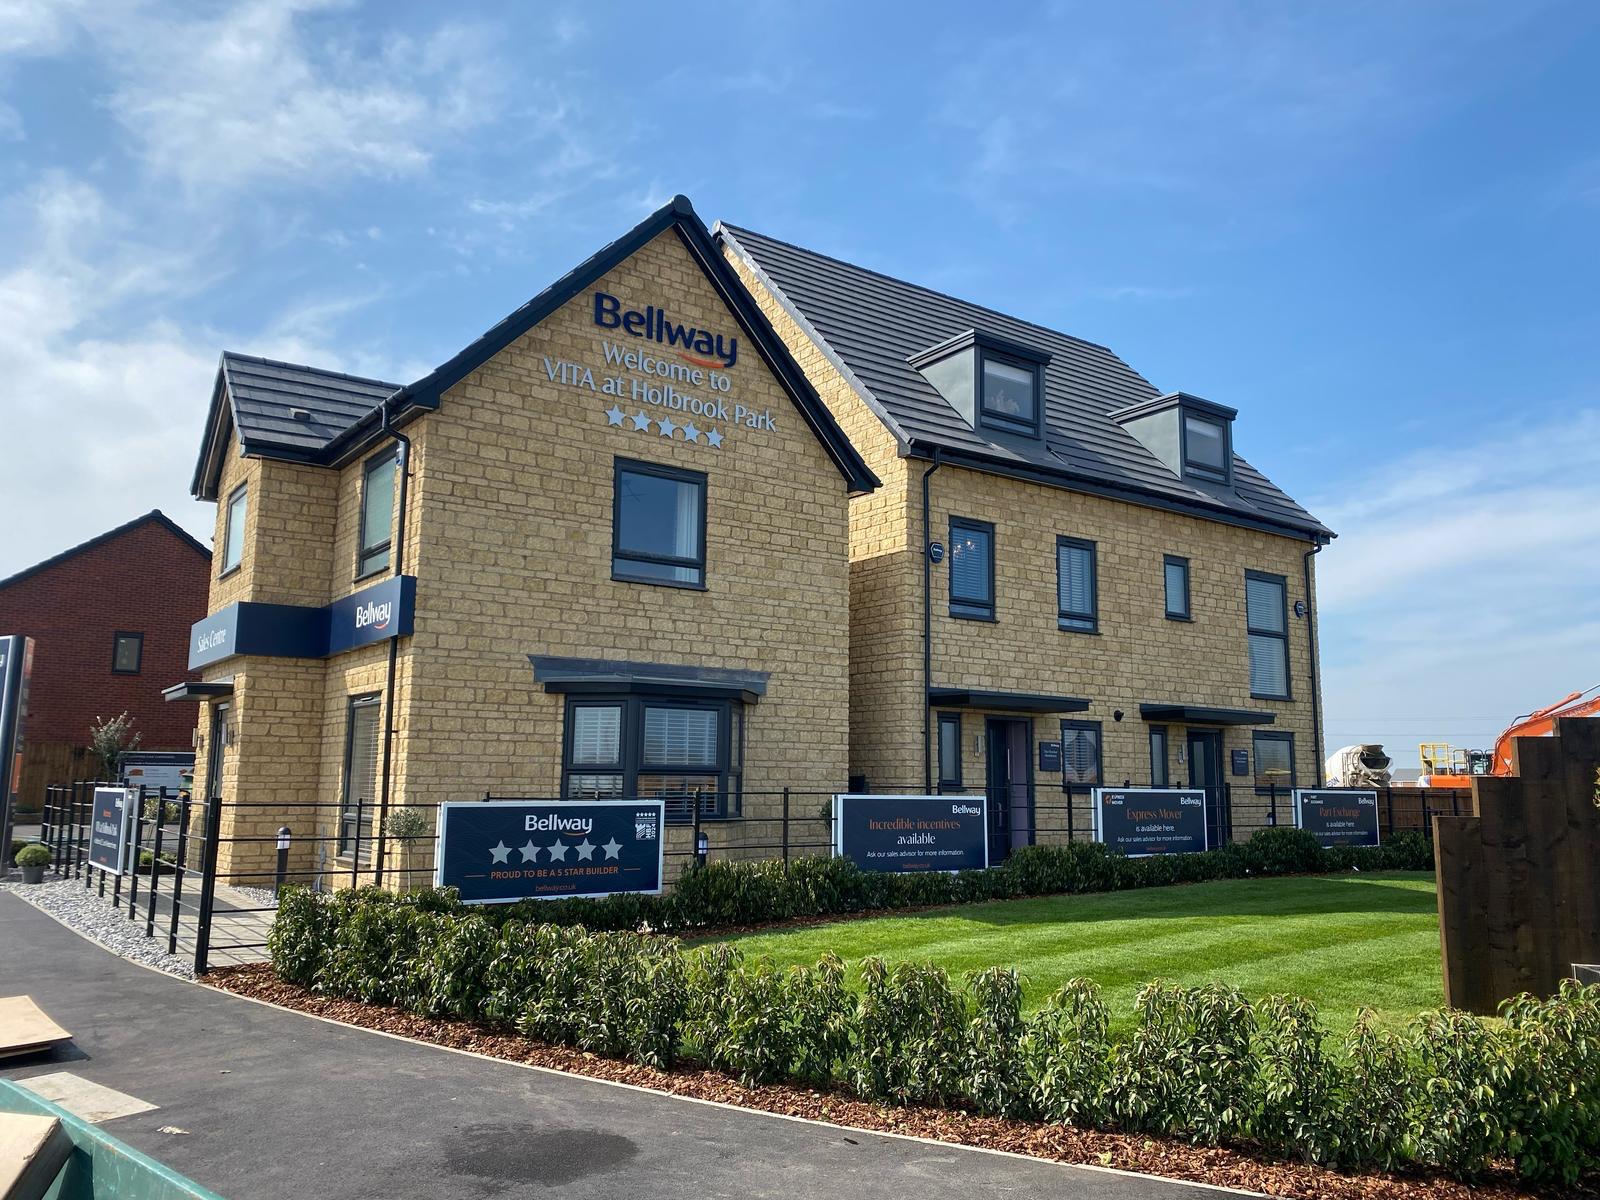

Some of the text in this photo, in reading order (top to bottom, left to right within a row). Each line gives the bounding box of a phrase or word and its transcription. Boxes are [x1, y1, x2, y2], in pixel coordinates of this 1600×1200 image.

[594, 291, 737, 368] Bellway
[602, 341, 731, 393] Welcome to
[543, 356, 777, 433] VITA at Holbrook Park
[355, 601, 392, 629] Bellway
[197, 628, 226, 653] Sales Centre
[1180, 797, 1202, 807] Bellway
[952, 804, 981, 816] Bellway
[1126, 808, 1183, 821] Express Mover
[524, 814, 593, 835] Bellway
[869, 818, 961, 830] Incredible incentives
[897, 832, 936, 845] available
[490, 866, 619, 880] PROUD TO BE A 5 STAR BUILDER
[535, 883, 577, 892] bellway.co.uk
